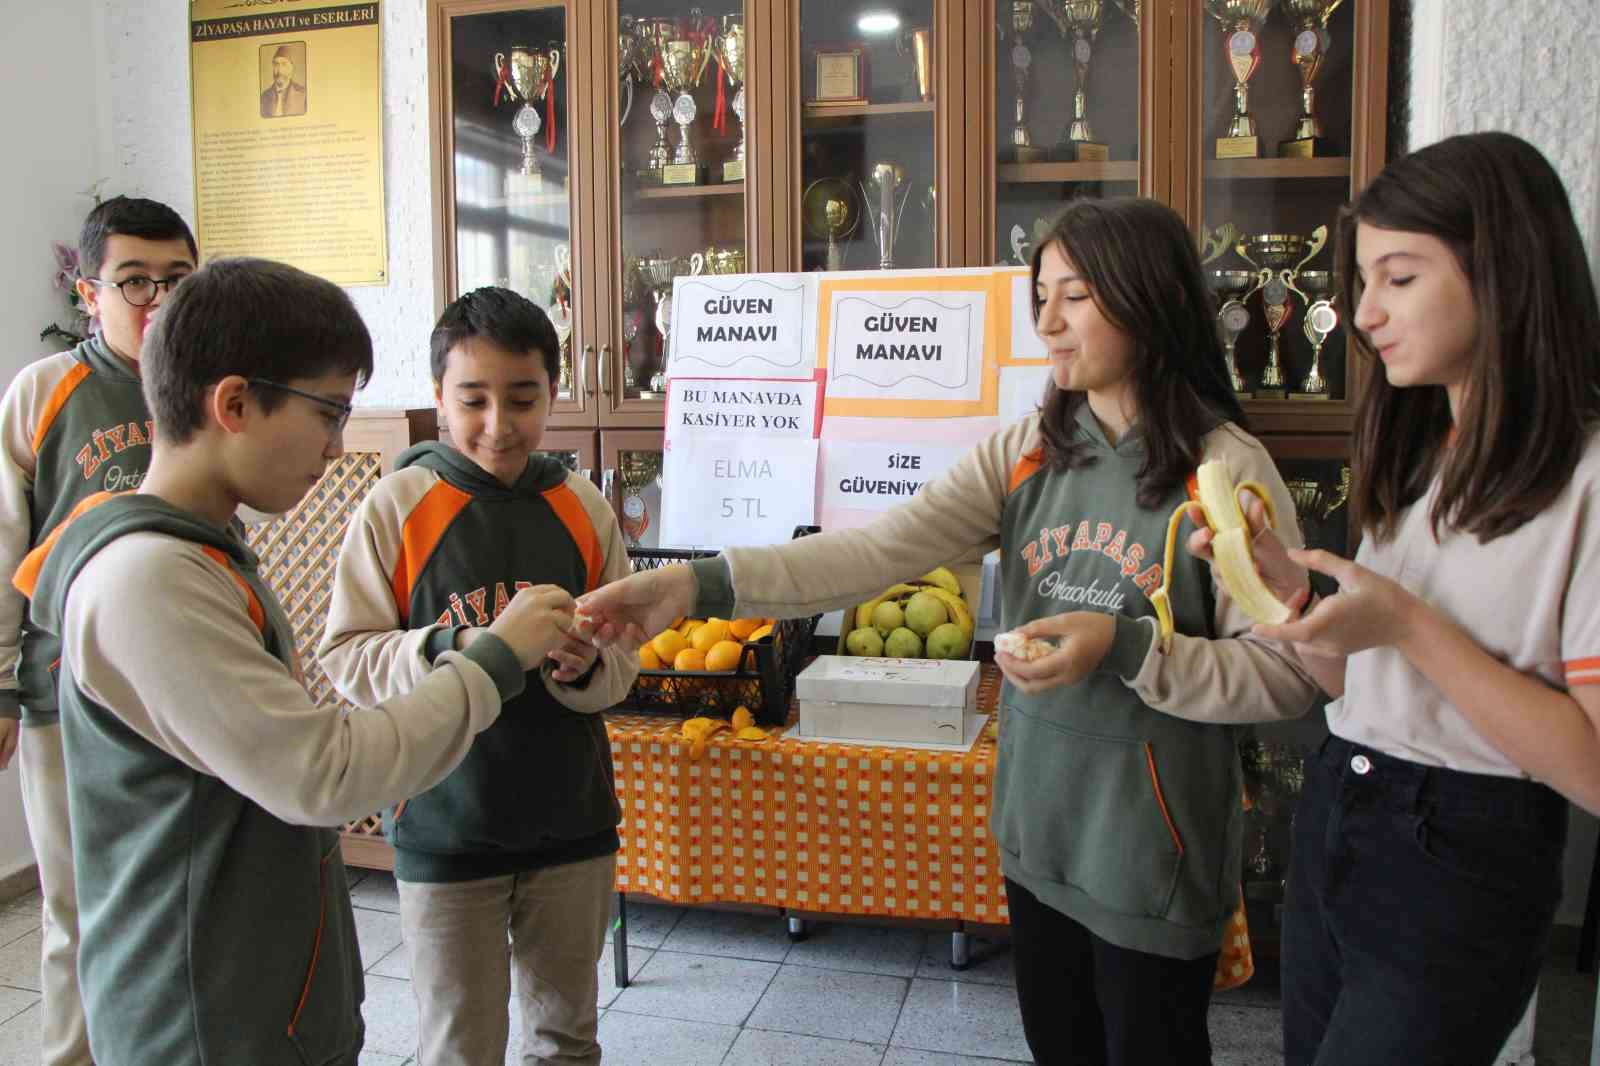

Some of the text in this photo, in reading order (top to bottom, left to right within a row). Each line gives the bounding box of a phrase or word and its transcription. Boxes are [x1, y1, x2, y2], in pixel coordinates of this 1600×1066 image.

[195, 8, 375, 37] ZİYAPAŞA HAYATI ve ESERLERİ
[704, 296, 773, 315] GÜVEN
[864, 312, 938, 333] GÜVEN
[696, 326, 778, 342] MANAVI
[856, 344, 942, 361] MANAVI
[683, 389, 803, 406] BU MANAVDA
[682, 411, 801, 430] KASİYER YOK
[714, 459, 773, 479] ELMA
[887, 453, 921, 470] SİZE
[839, 476, 924, 496] GÜVENİY
[721, 497, 768, 519] 5 TL
